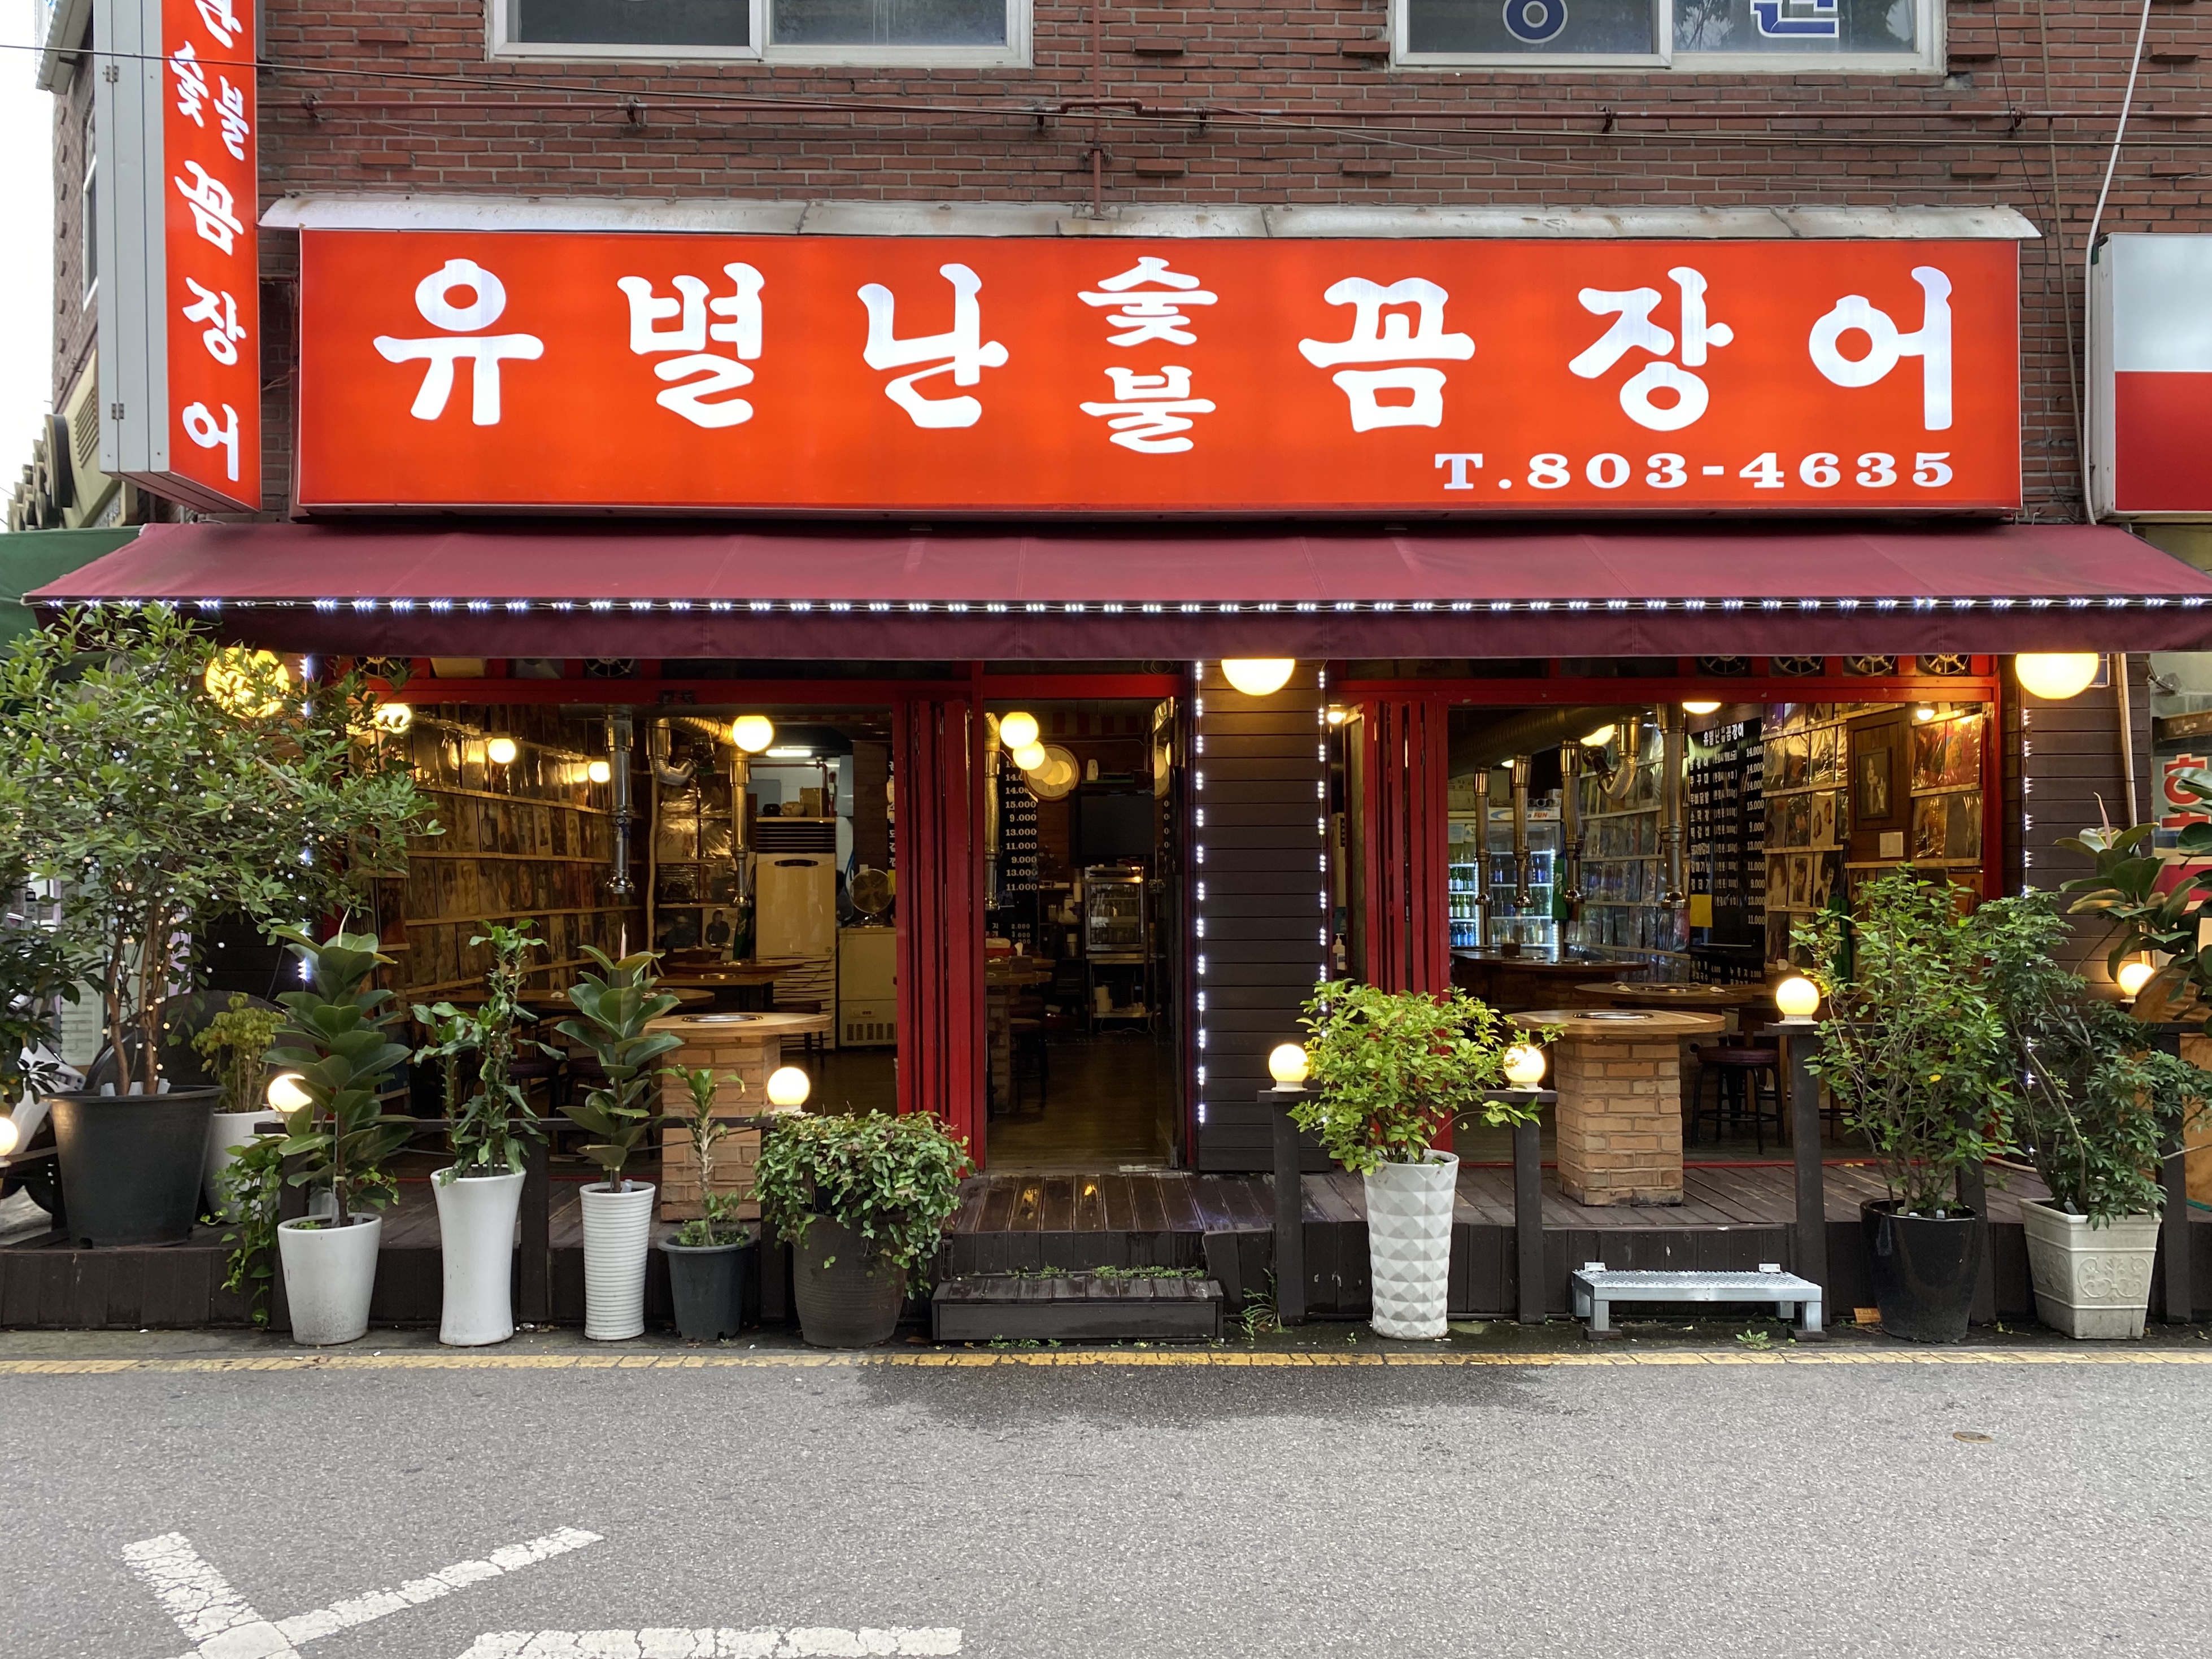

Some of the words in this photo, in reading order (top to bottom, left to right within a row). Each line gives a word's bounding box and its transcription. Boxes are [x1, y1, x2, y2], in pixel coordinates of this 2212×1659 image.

[373, 259, 1008, 428] 유별난
[1299, 267, 1952, 432] 꼼장어
[1435, 452, 1952, 489] T.803-4635
[1747, 746, 1763, 757] 14.000
[1747, 800, 1764, 811] 15.000
[1751, 879, 1765, 888] 9.000
[1748, 915, 1765, 925] 11.000
